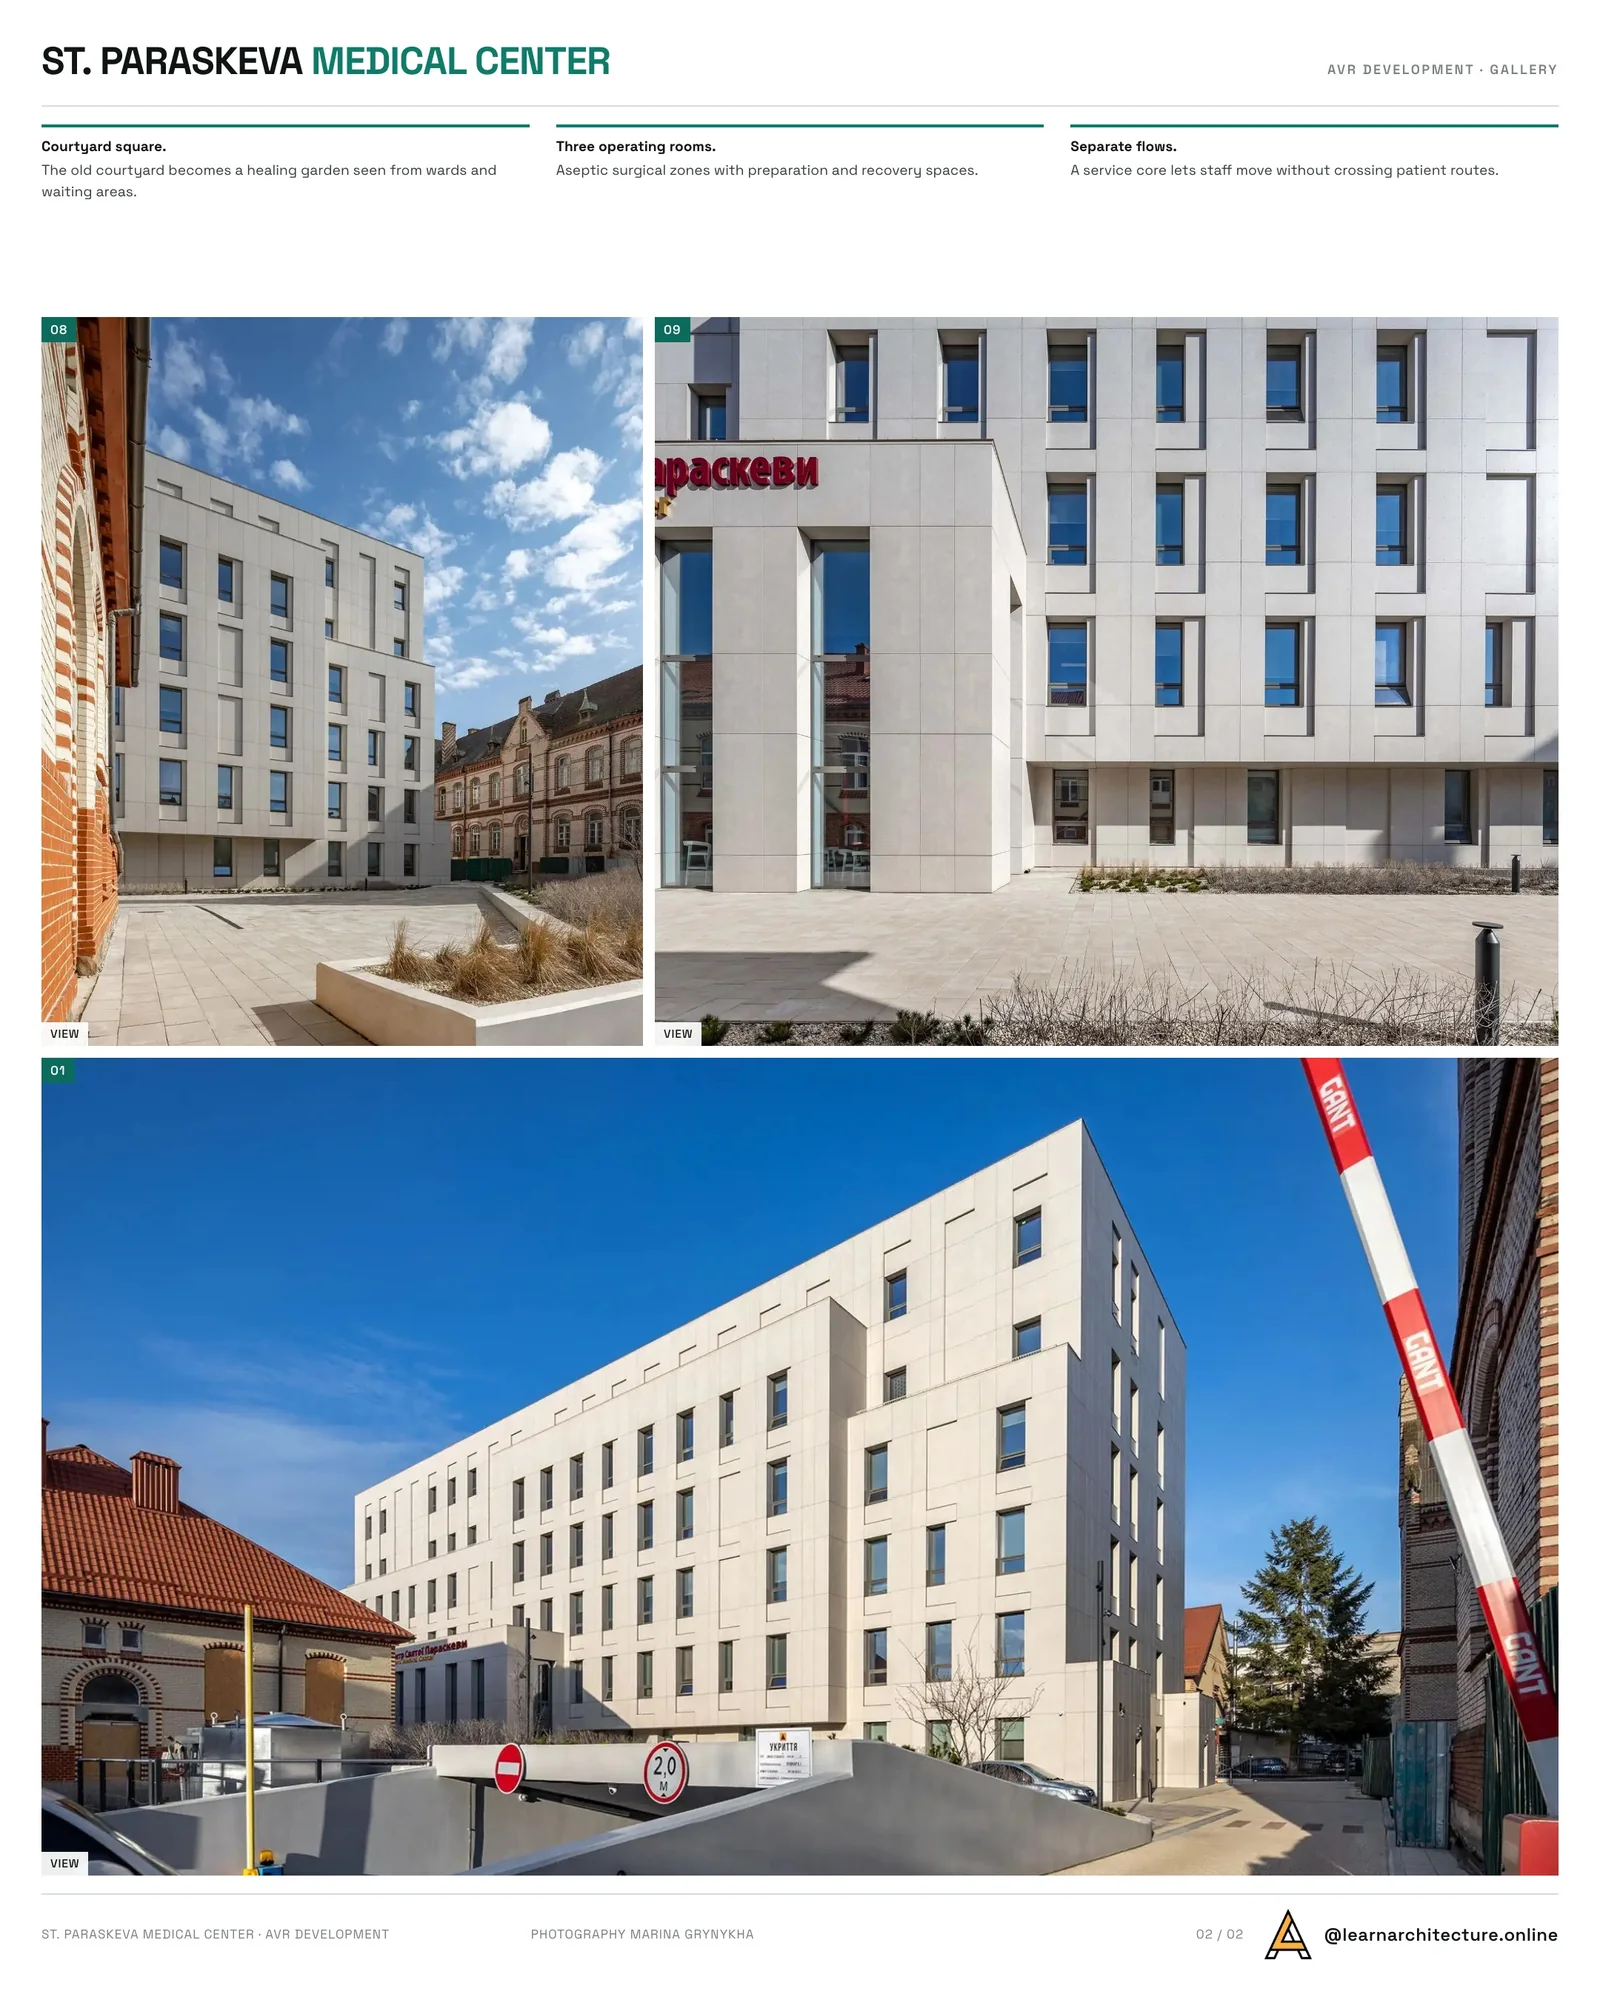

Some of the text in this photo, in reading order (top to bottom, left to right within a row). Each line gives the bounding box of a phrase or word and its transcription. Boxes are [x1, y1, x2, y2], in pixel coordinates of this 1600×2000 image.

[1320, 1075, 1357, 1132] GANT
[1405, 1331, 1444, 1391] GANT
[425, 1640, 468, 1655] Параскеви
[1505, 1632, 1548, 1695] GANT
[769, 1742, 798, 1751] УКРИТТЯ
[653, 1756, 677, 1779] 2,0
